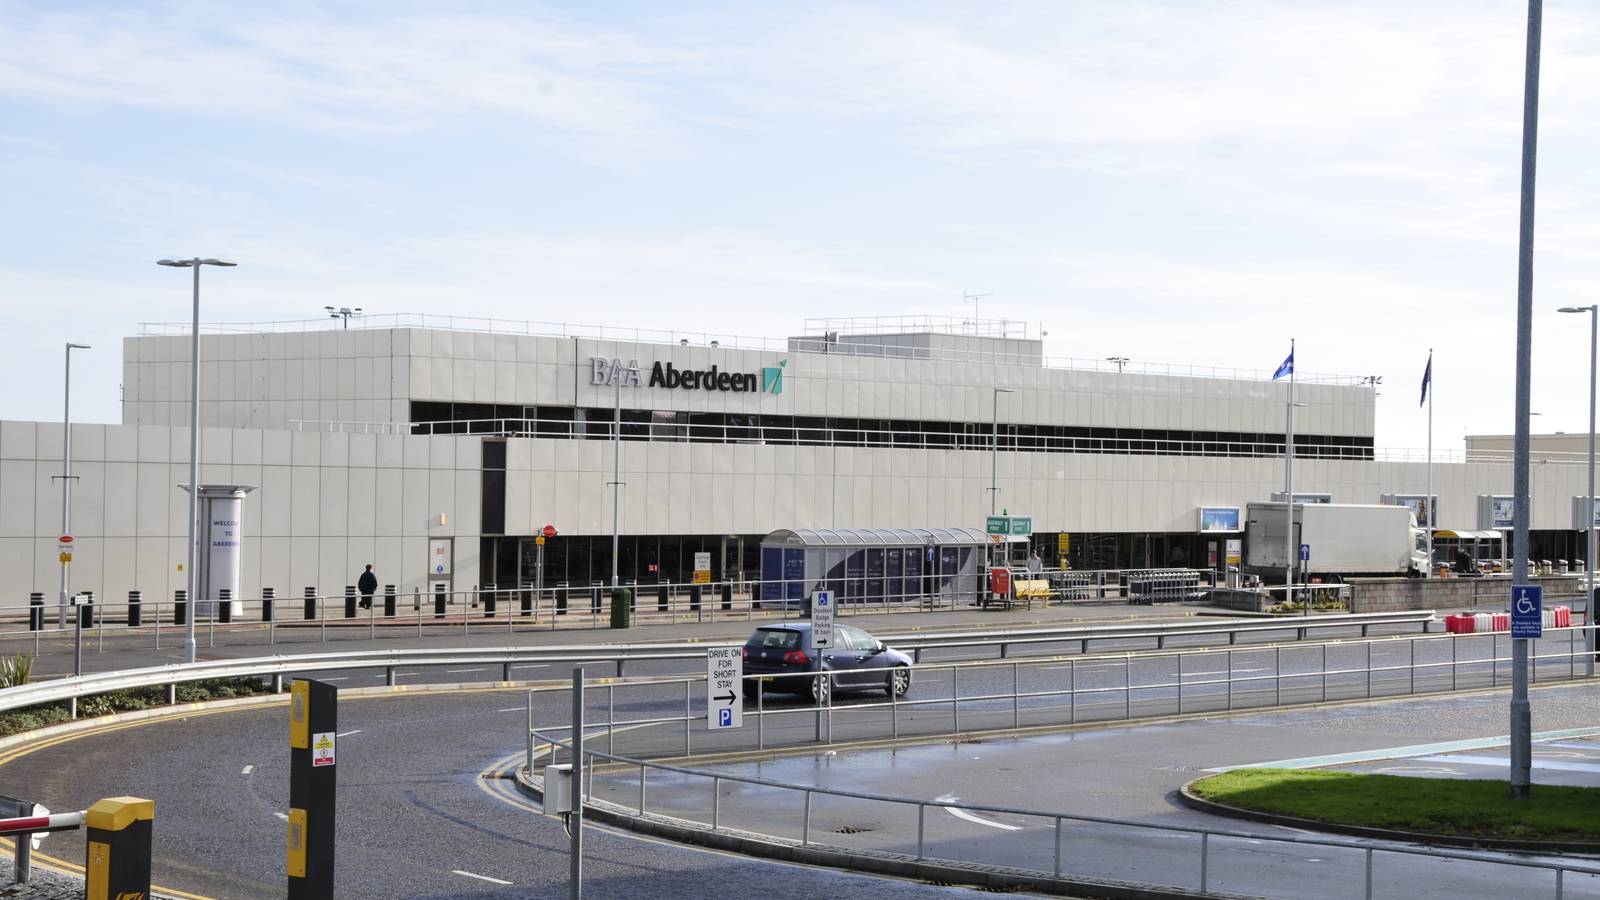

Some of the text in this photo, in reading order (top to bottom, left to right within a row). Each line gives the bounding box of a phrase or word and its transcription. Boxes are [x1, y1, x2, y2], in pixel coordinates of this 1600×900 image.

[591, 357, 757, 392] BAA Aberdeen
[709, 649, 741, 658] DRIVE ON
[718, 660, 732, 668] FOR
[713, 670, 736, 679] SHORT
[721, 709, 730, 726] P
